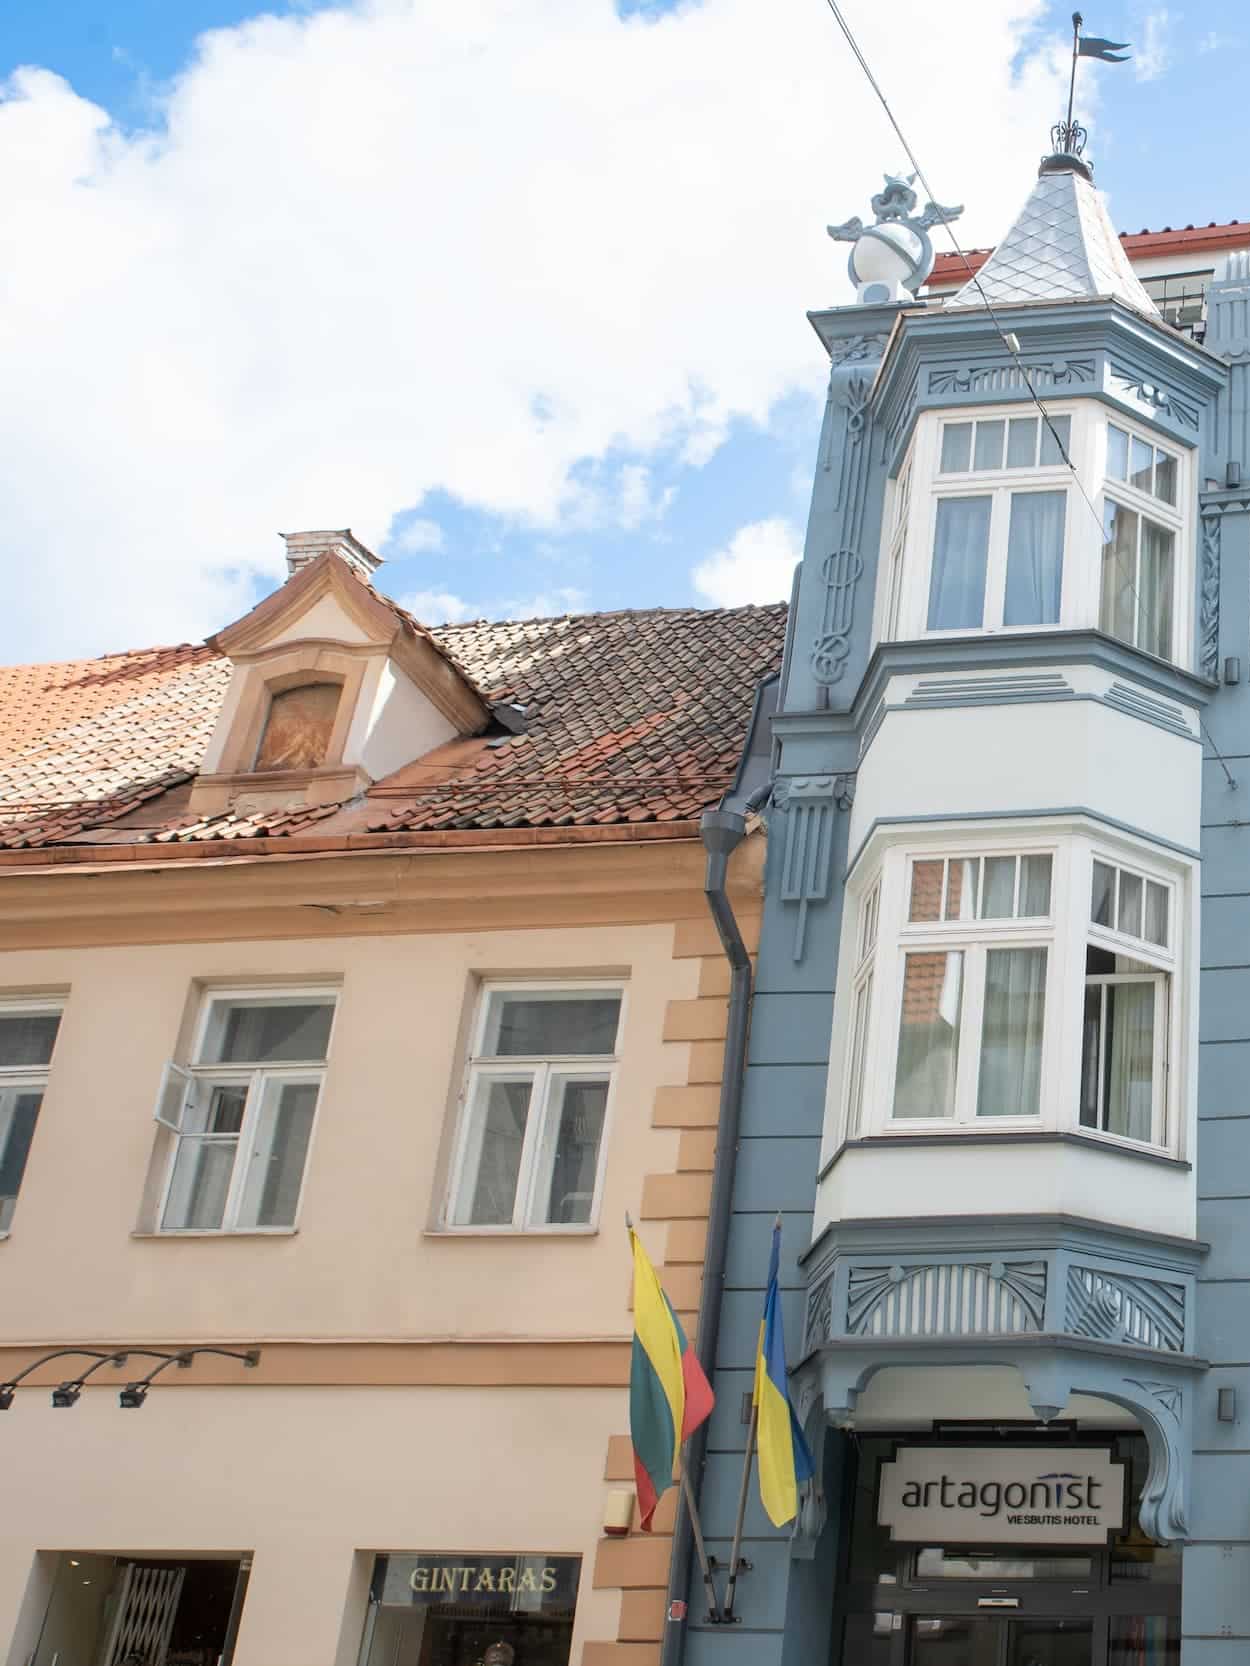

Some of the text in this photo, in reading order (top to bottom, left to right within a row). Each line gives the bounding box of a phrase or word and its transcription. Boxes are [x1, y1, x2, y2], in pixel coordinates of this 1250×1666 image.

[902, 1472, 1103, 1517] artagonist
[1007, 1515, 1101, 1526] VIESBUTIS HOTEL
[409, 1567, 559, 1593] GINTARAS
